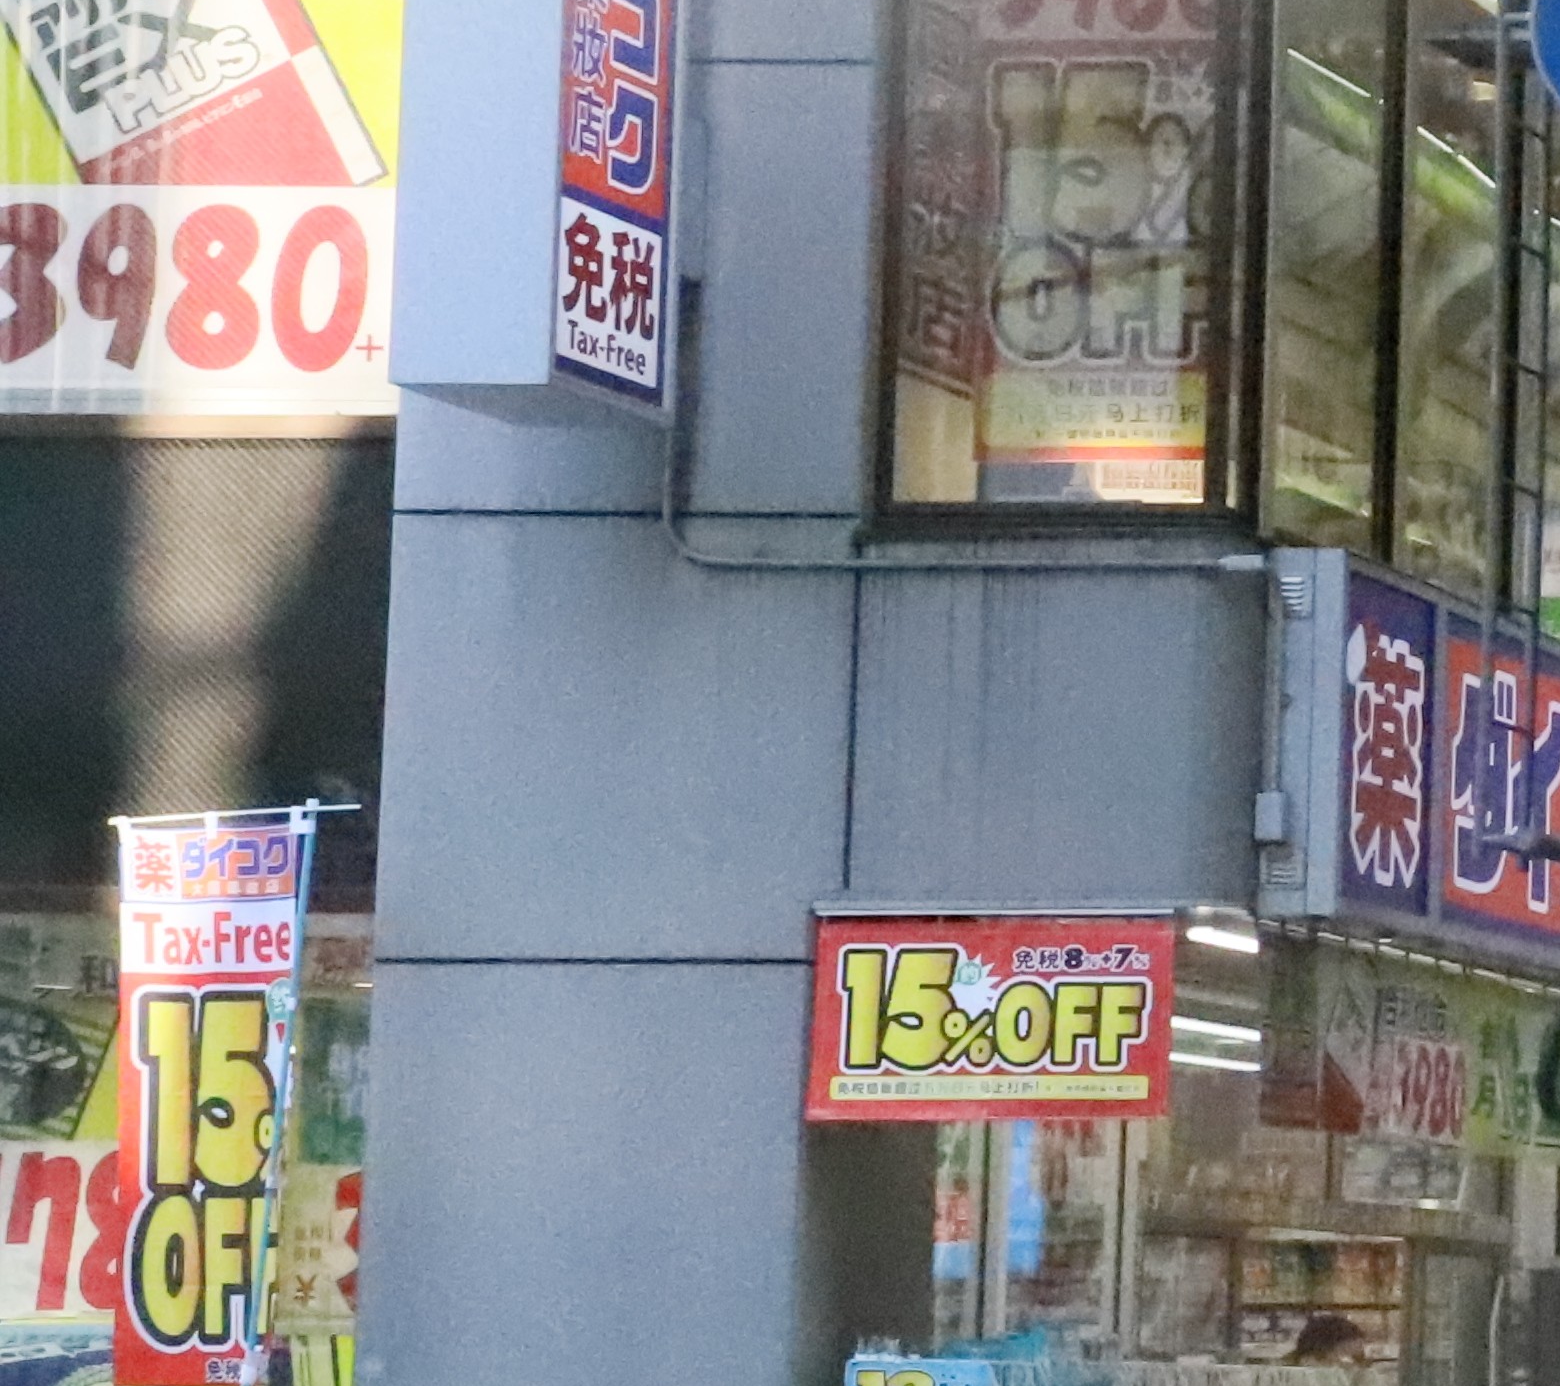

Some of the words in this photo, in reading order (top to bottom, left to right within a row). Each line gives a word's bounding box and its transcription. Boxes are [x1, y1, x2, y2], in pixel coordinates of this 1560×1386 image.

[105, 25, 261, 134] PLUS
[0, 202, 368, 372] 3980
[563, 213, 655, 340] 免税
[567, 318, 647, 376] Tax-Free
[1346, 624, 1425, 889] 薬
[132, 835, 175, 897] 薬
[182, 837, 290, 878] ダイコク
[132, 911, 291, 966] Tax-Free
